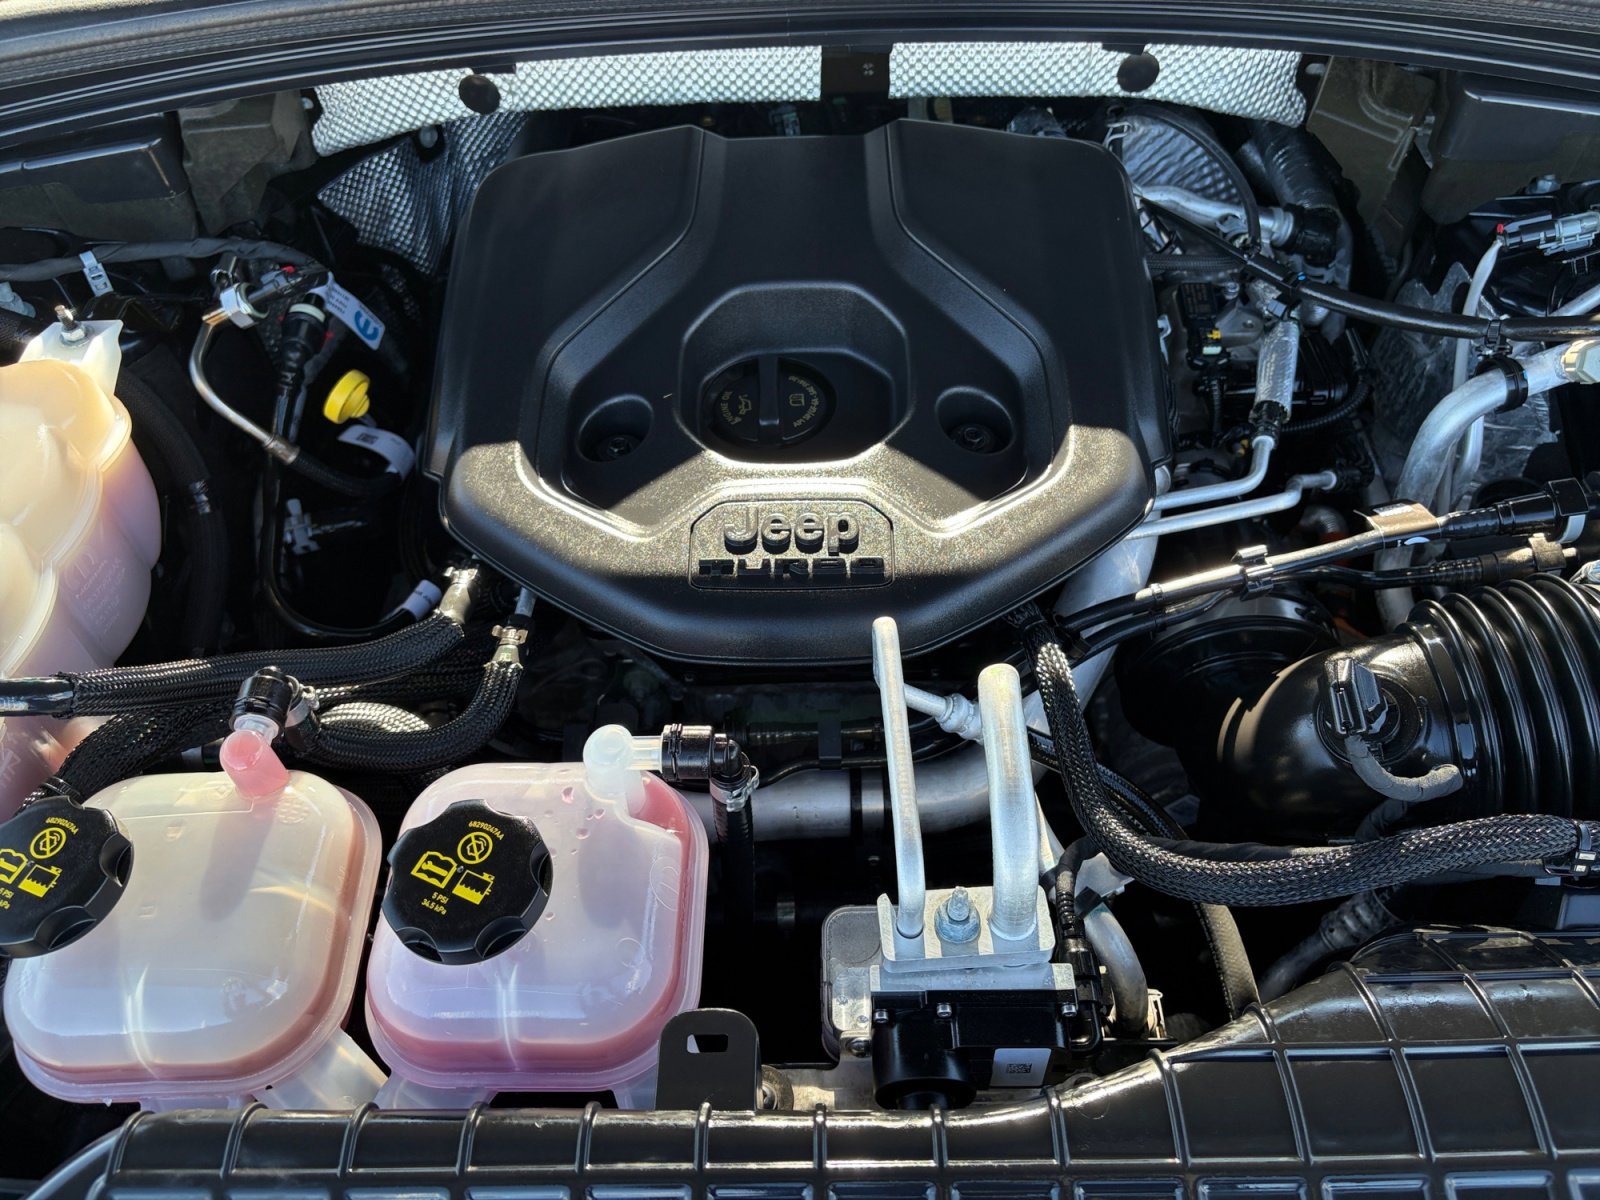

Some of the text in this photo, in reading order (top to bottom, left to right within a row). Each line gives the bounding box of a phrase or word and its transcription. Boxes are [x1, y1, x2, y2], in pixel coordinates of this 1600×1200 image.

[724, 507, 860, 556] Jeep
[432, 891, 448, 904] 5 PSI
[434, 904, 446, 915] kPa
